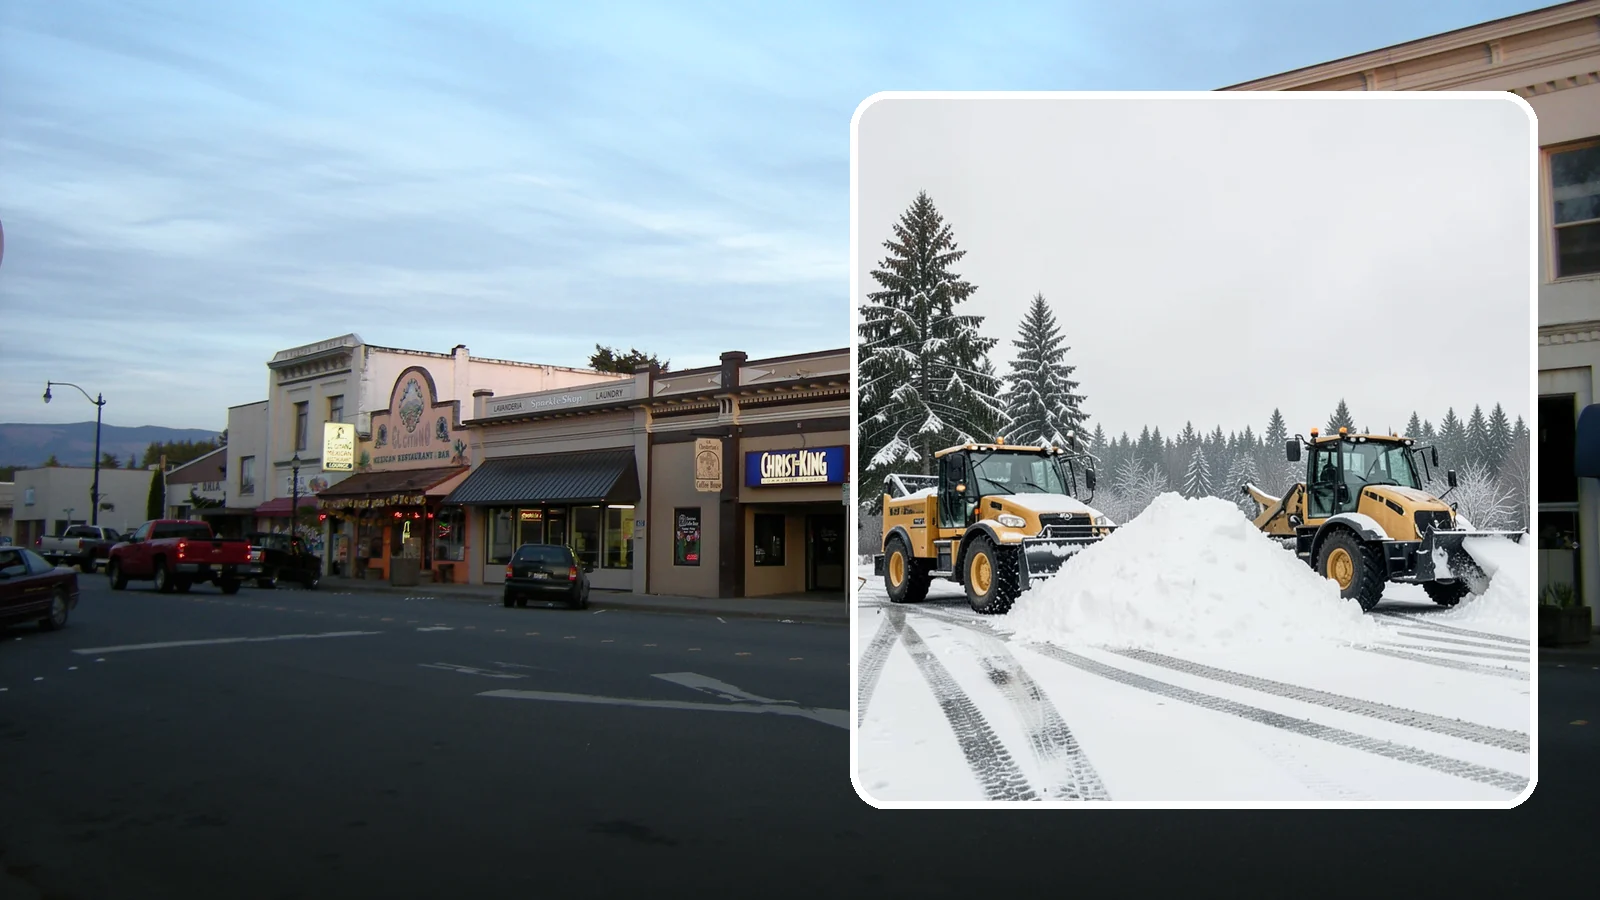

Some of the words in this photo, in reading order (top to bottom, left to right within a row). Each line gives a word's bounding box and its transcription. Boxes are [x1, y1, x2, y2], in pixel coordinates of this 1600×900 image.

[493, 402, 522, 413] LAVANDERIA
[530, 396, 561, 408] Sparkle
[562, 394, 582, 406] Shop
[595, 389, 623, 400] LAUNDRY
[374, 455, 396, 464] MEXICAN
[397, 451, 433, 462] RESTAURANT
[438, 450, 450, 459] BAR
[760, 452, 797, 478] CHRIST
[798, 450, 827, 476] KING
